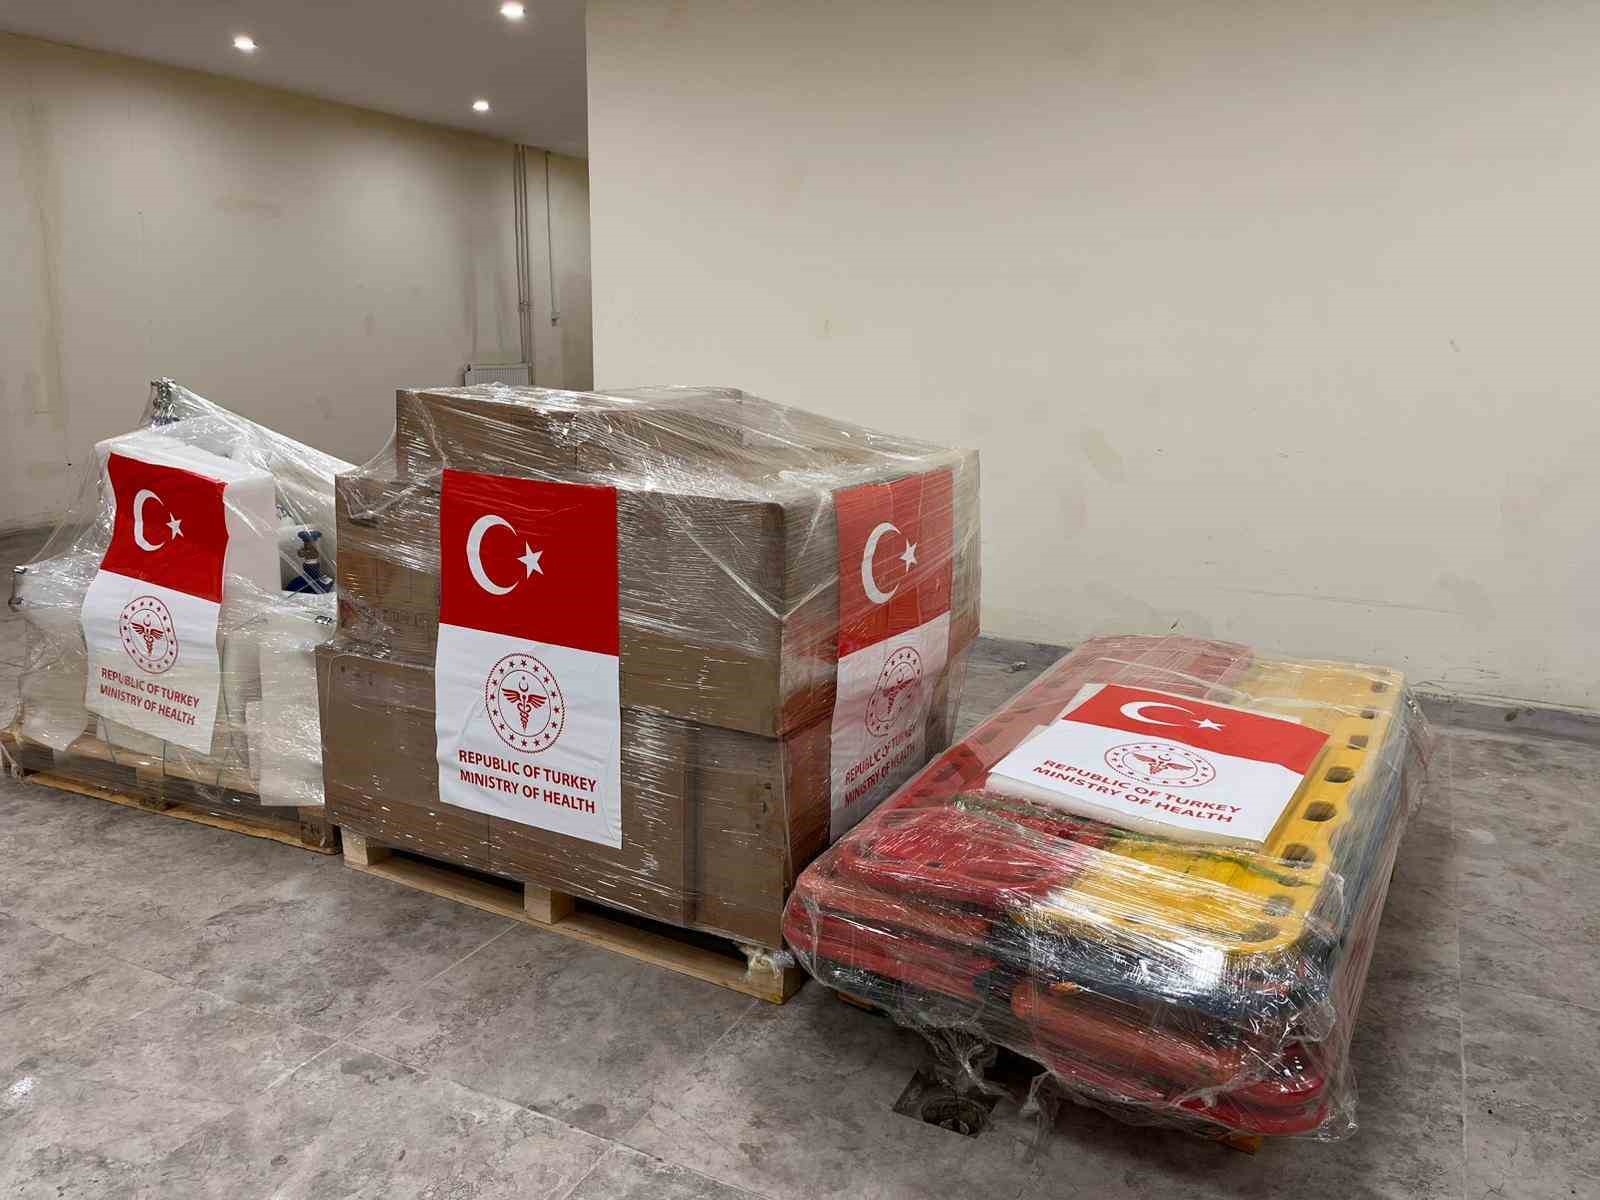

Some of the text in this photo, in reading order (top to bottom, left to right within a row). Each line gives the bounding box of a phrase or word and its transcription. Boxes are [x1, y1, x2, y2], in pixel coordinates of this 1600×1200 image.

[100, 684, 195, 725] MINISTRY OF HEALTH
[101, 667, 200, 708] REPUBLIC OF TURKEY
[459, 750, 596, 792] REPUBLIC OF TURKEY
[459, 770, 595, 814] MINISTRY OF HEALTH
[1043, 760, 1242, 813] REPUBLIC OF TURKEY
[1033, 766, 1233, 823] MINISTRY OF HEALTH
